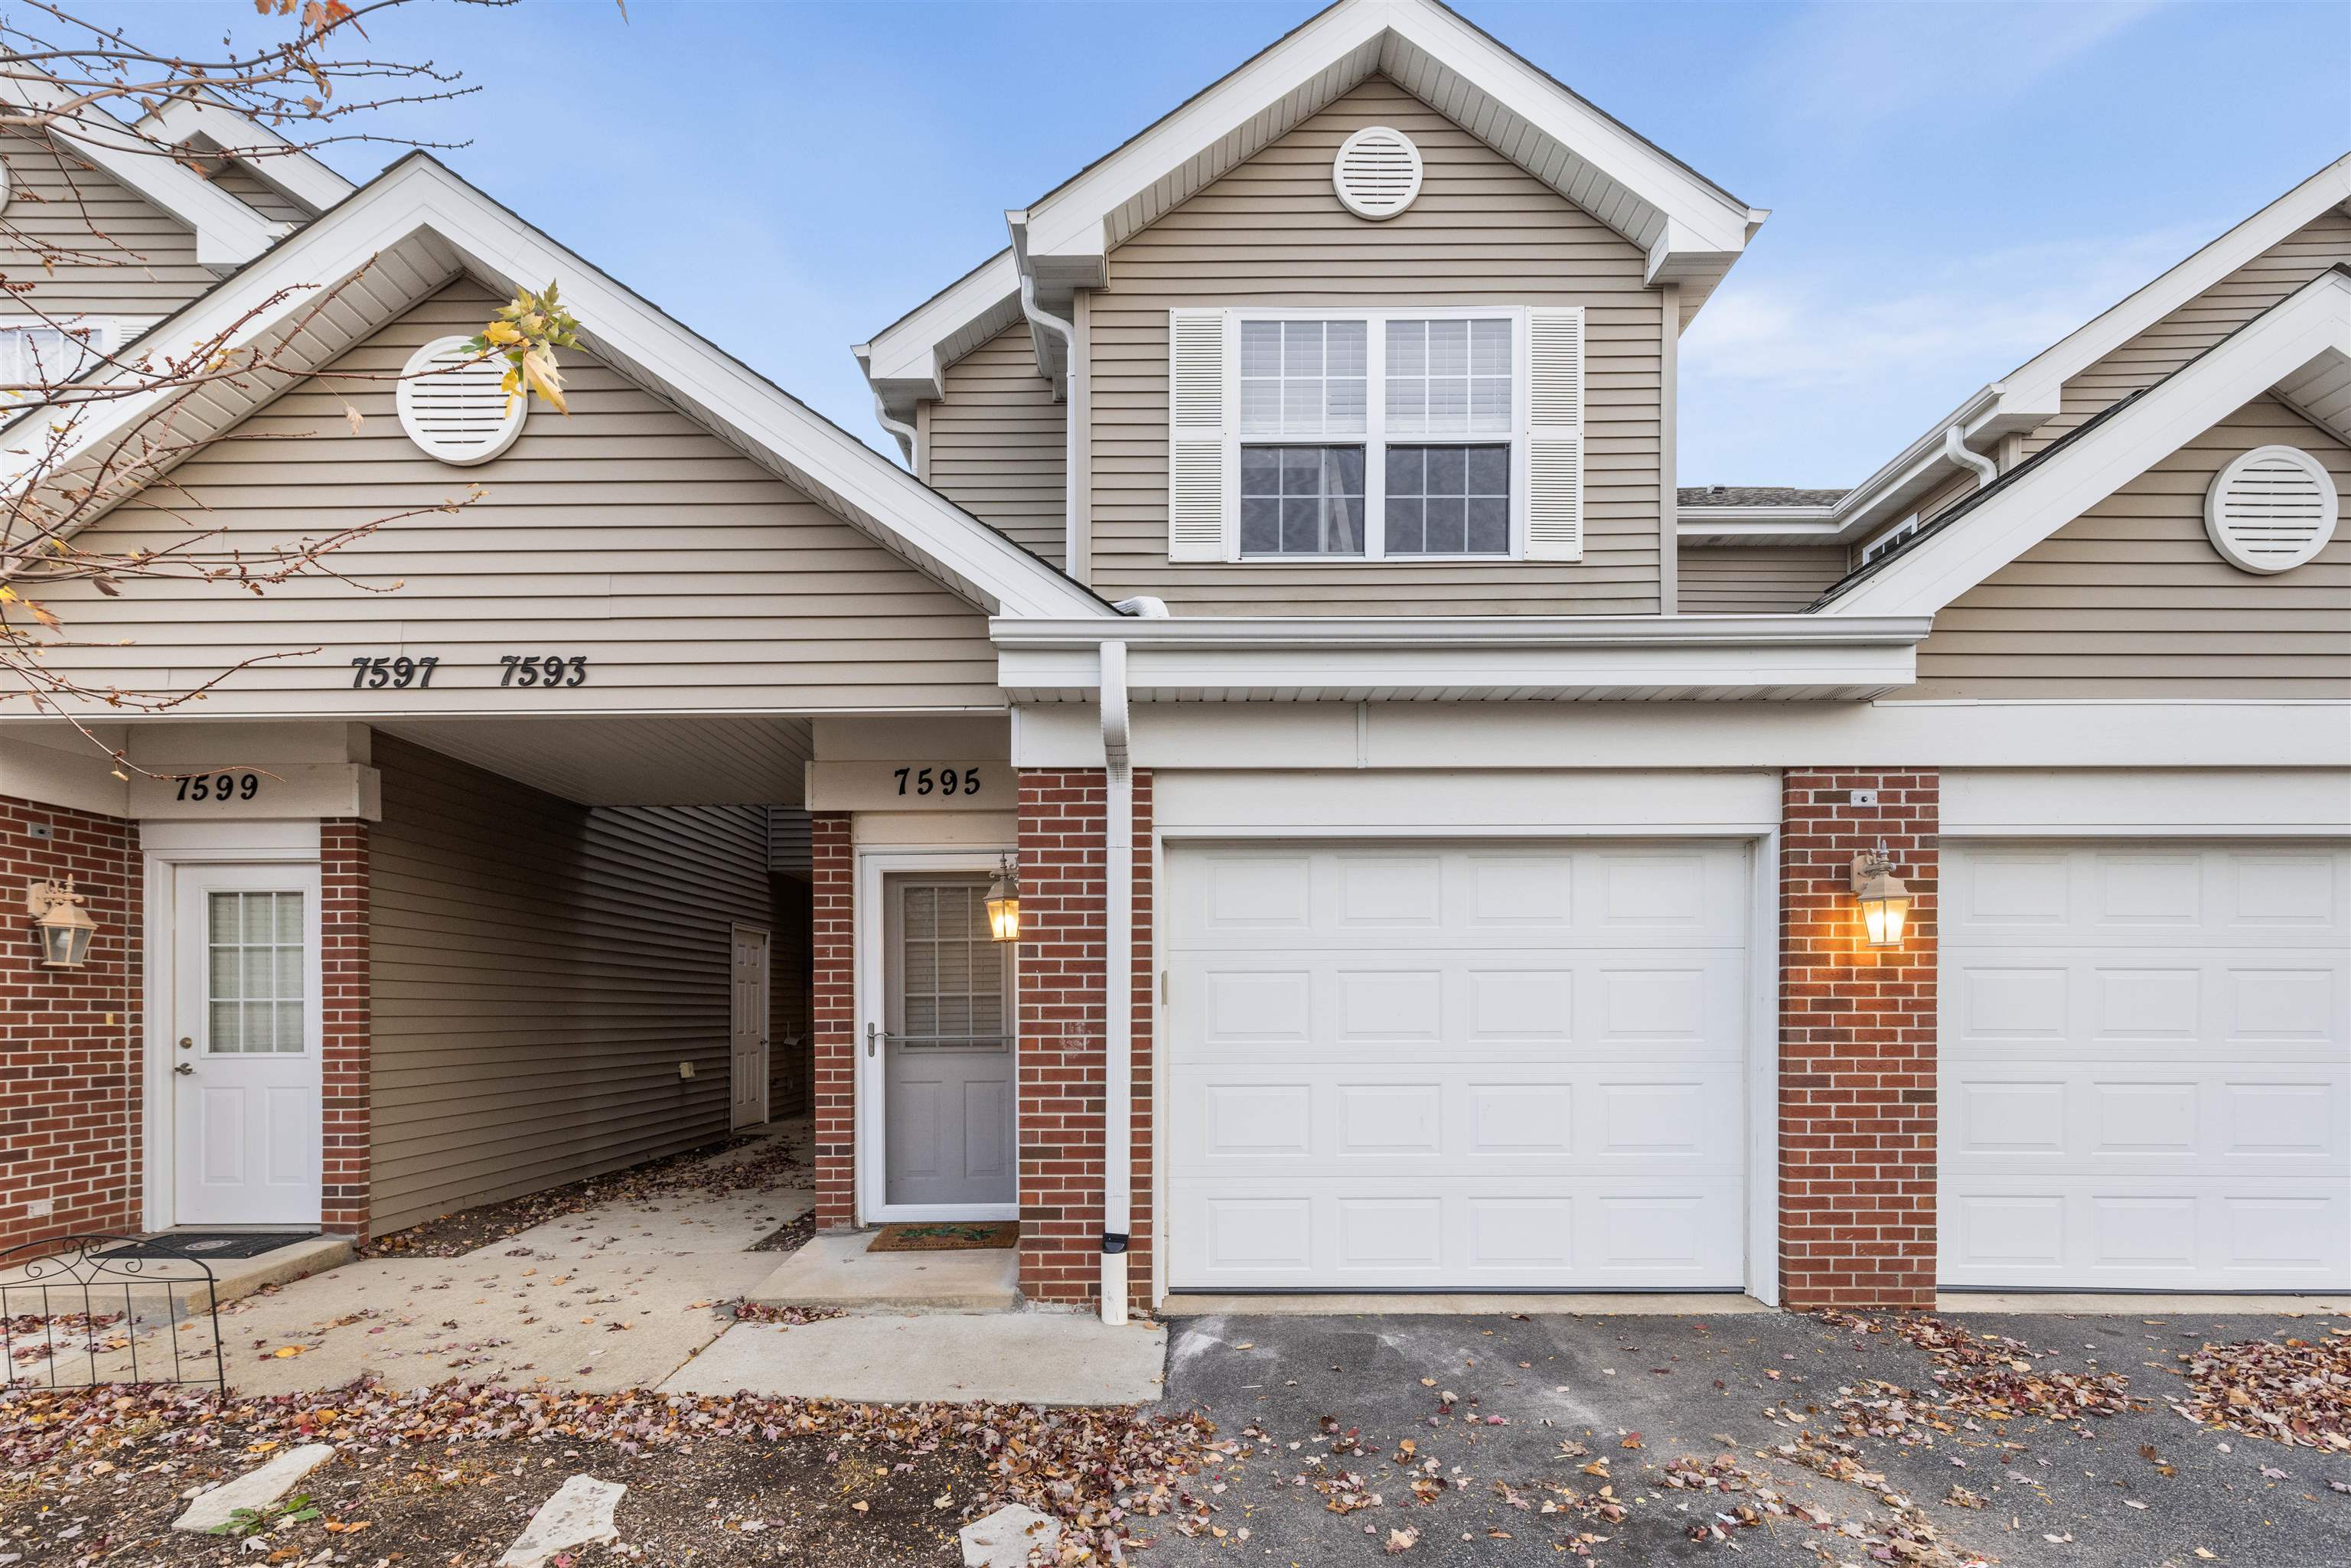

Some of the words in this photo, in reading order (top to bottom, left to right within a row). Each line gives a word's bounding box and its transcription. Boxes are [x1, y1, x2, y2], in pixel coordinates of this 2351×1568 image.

[352, 657, 439, 688] 7597
[501, 656, 587, 687] 7593
[176, 774, 258, 801] 7599
[895, 767, 980, 796] 7595
